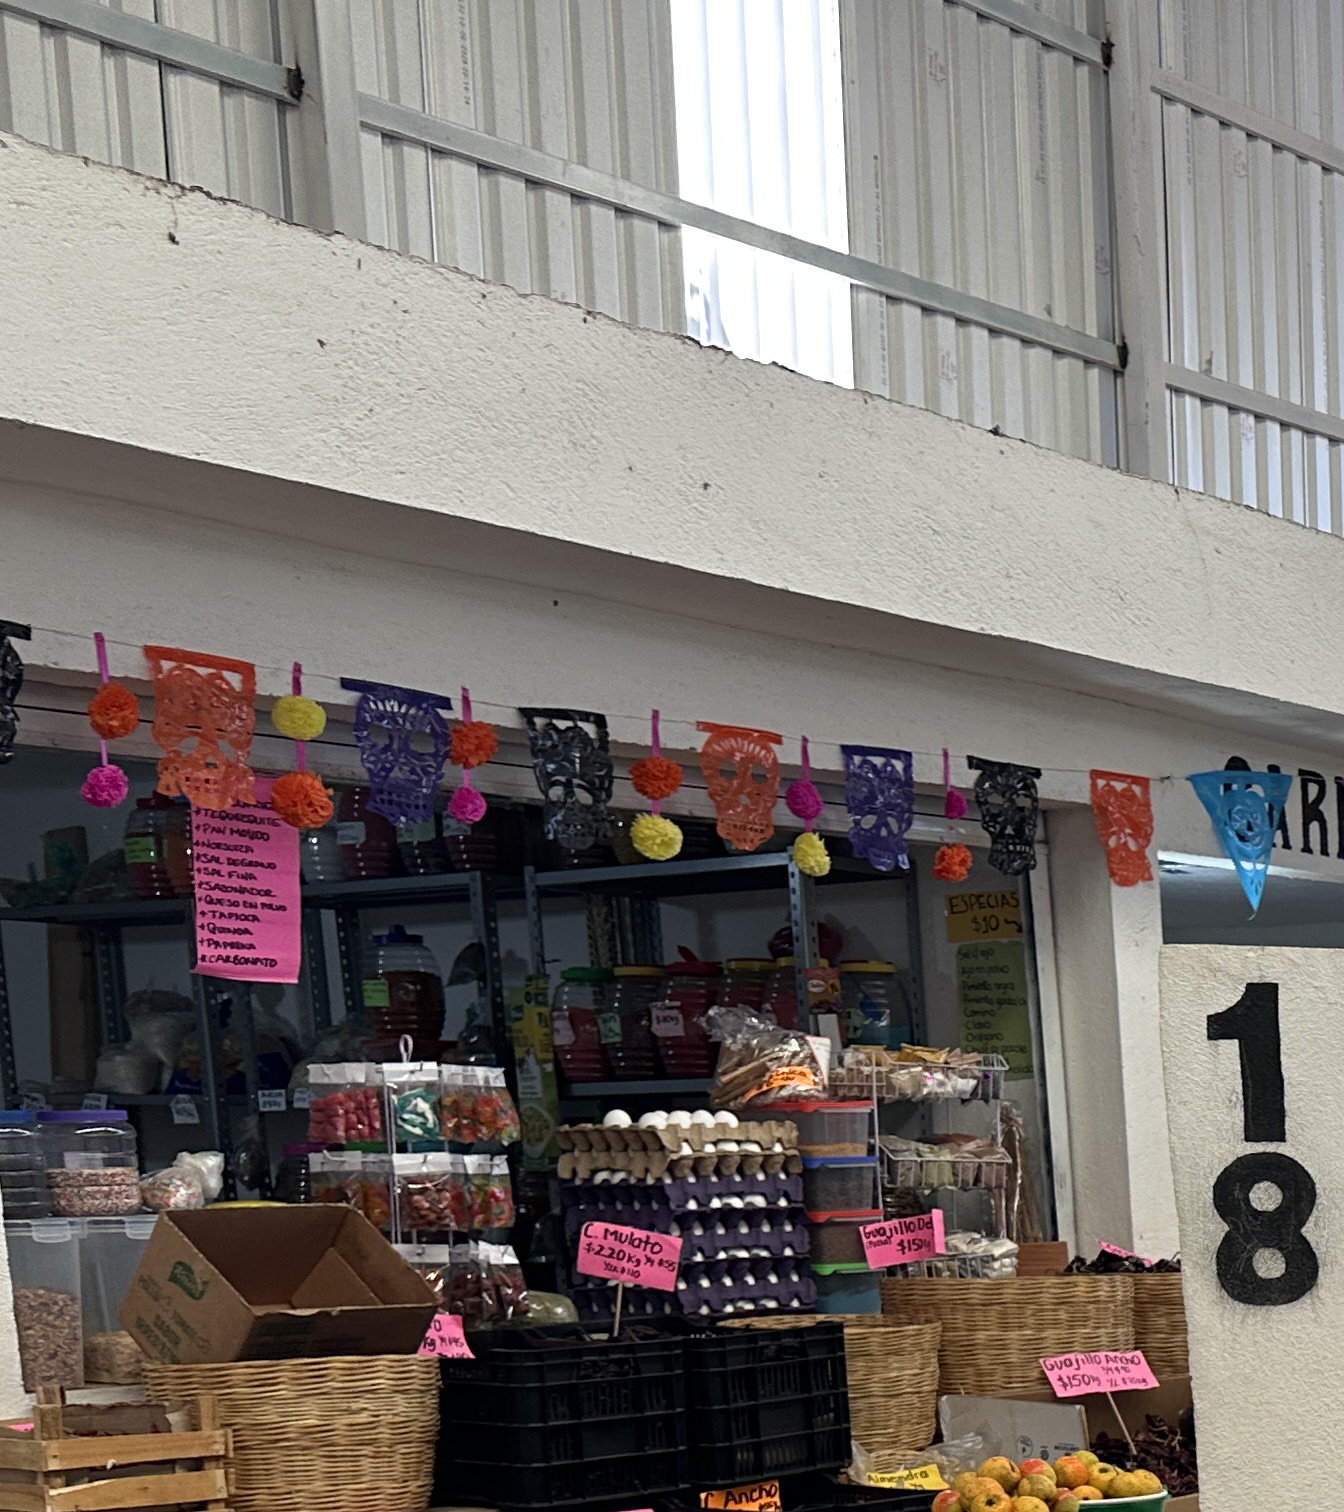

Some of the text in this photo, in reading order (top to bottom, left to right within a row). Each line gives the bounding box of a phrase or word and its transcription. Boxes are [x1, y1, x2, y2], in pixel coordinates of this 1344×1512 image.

[949, 891, 1020, 915] ESPECIAS
[970, 914, 999, 934] $10
[1206, 982, 1320, 1307] 18
[603, 1228, 663, 1255] Mulato
[1043, 1354, 1102, 1372] Guajillo
[723, 1483, 778, 1509] Ancho
